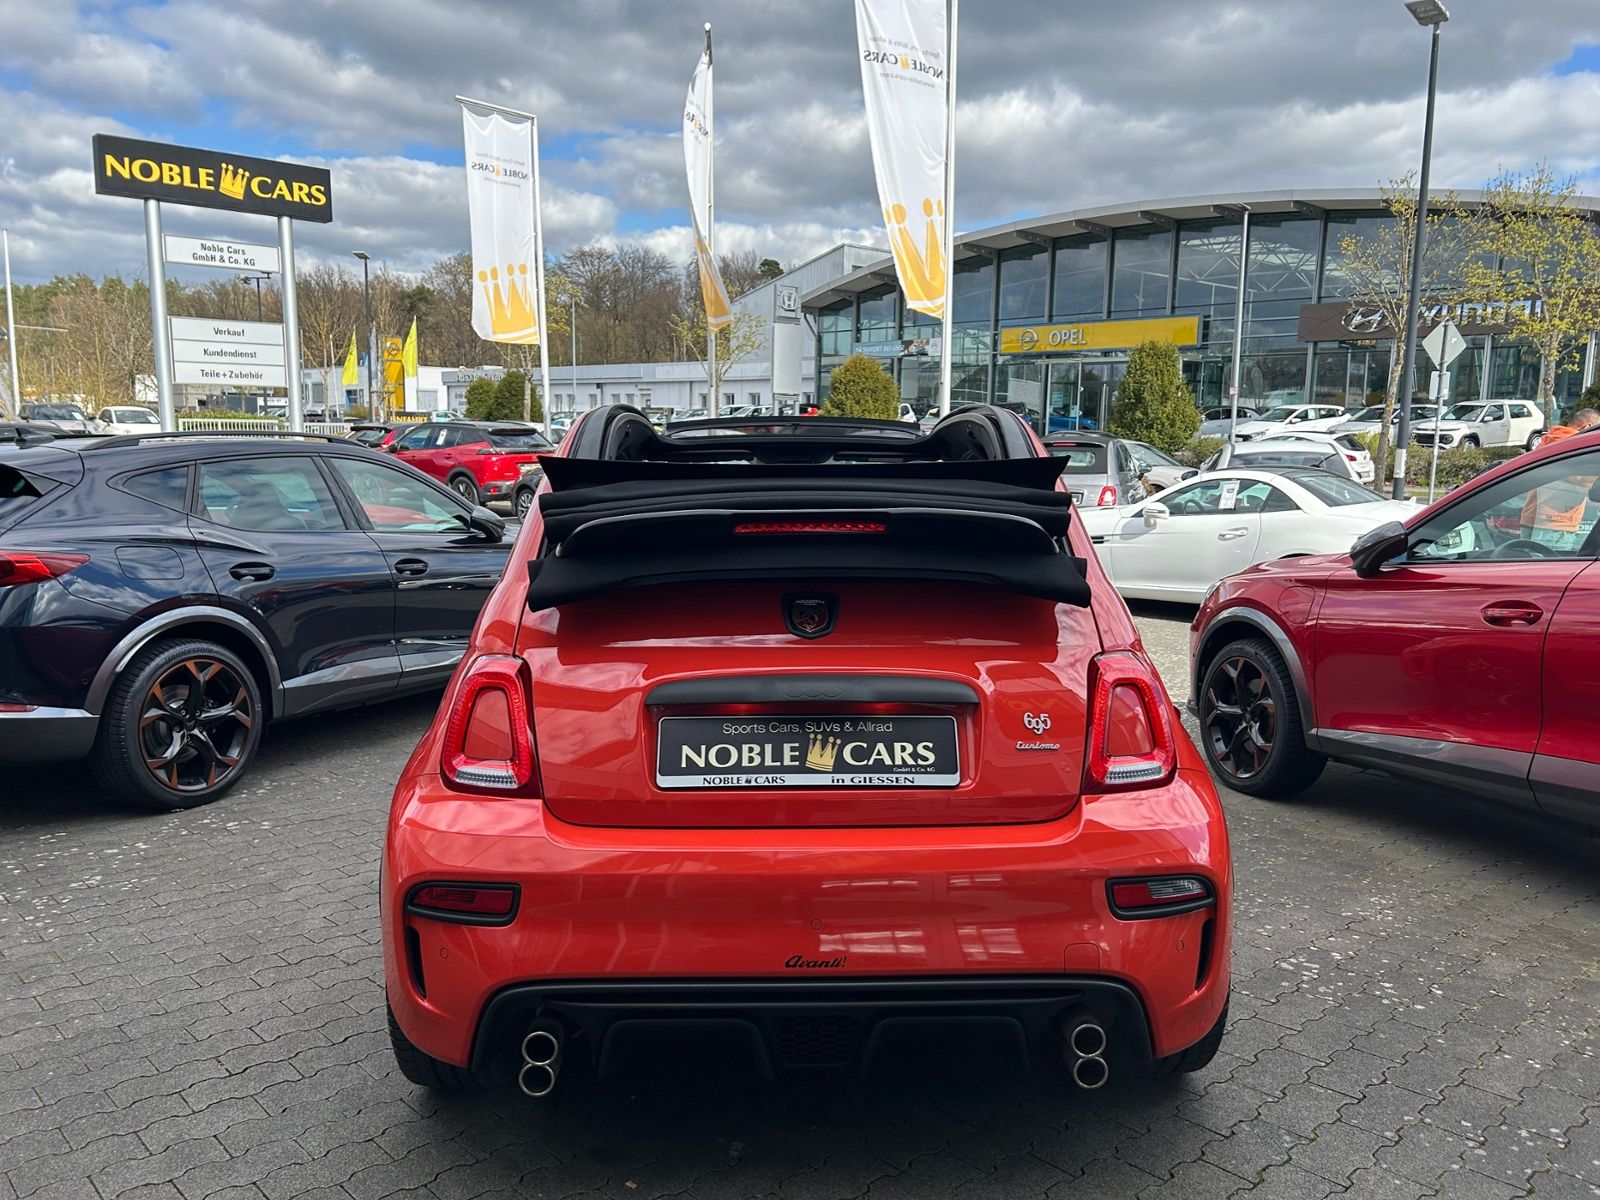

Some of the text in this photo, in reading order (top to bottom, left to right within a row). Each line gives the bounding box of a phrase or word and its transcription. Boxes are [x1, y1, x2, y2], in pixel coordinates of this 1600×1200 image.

[104, 154, 327, 206] NOBLE CARS
[200, 243, 246, 256] Noble Cars
[192, 252, 256, 267] GmbH & Co. KG
[213, 327, 245, 337] Verkauf
[1049, 328, 1087, 346] OPEL
[203, 348, 257, 359] Kundendienst
[722, 721, 893, 736] Sports Cars, SUVs & Allrad
[1023, 712, 1051, 735] 695
[680, 741, 936, 768] NOBLE CARS
[702, 775, 915, 785] NOBLE CARS in GIESSEN
